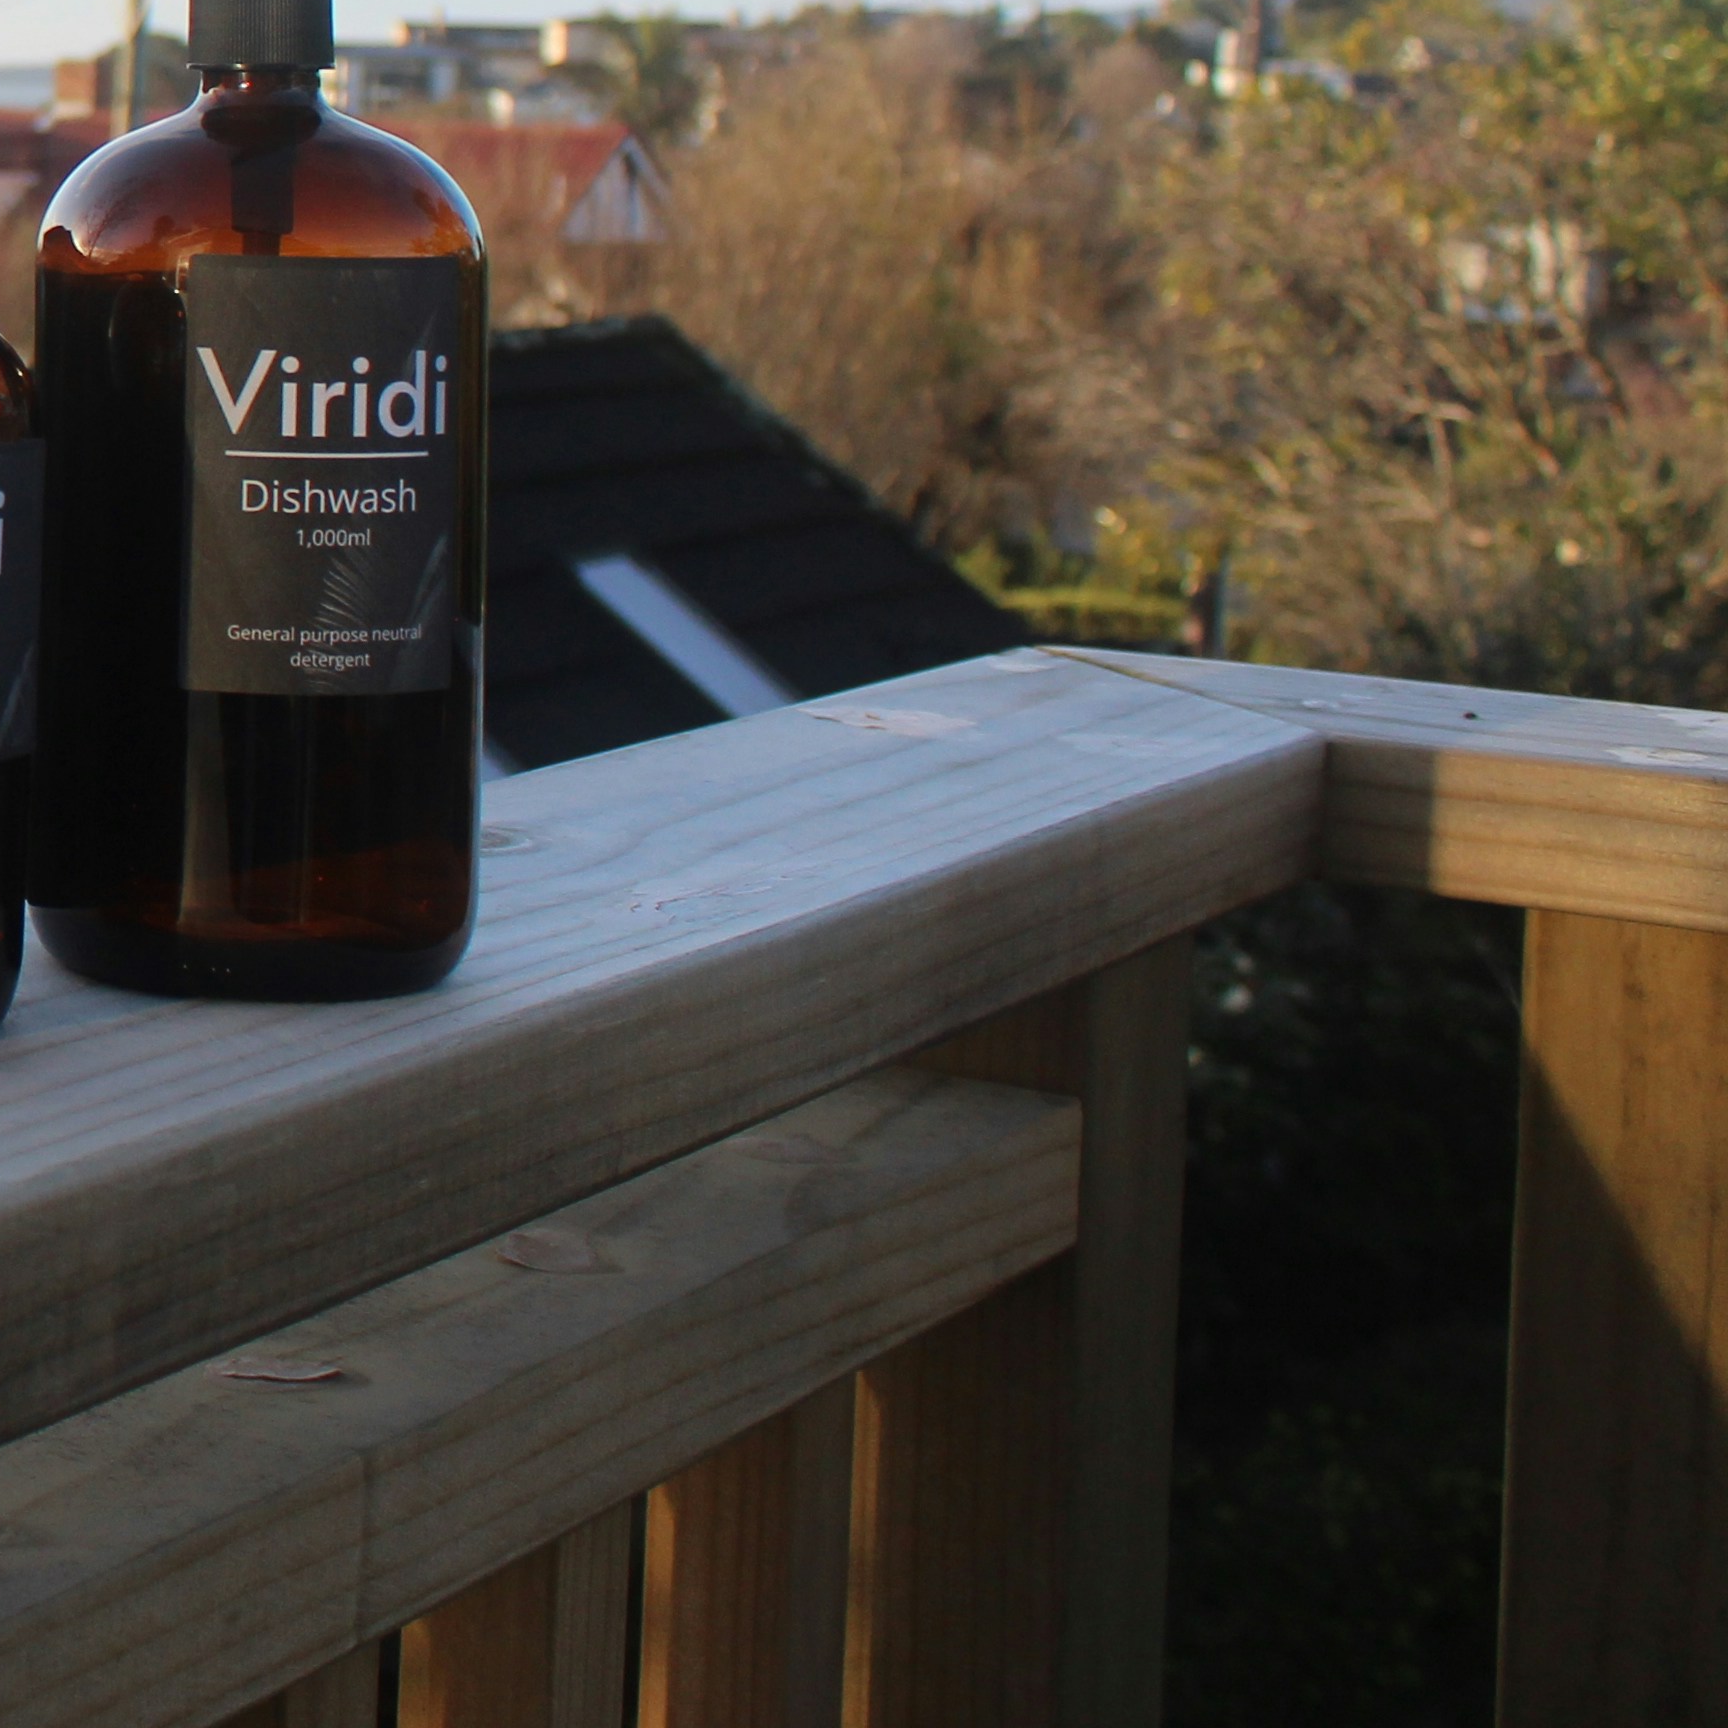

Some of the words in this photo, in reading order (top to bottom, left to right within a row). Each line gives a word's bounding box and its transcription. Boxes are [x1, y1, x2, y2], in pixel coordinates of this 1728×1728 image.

[196, 346, 448, 438] Viridi
[240, 479, 417, 515] Dishwash
[295, 528, 371, 549] 1,000ml
[226, 623, 295, 643] General
[299, 627, 368, 647] purpose
[372, 623, 422, 642] neutral
[289, 651, 370, 672] detergent
